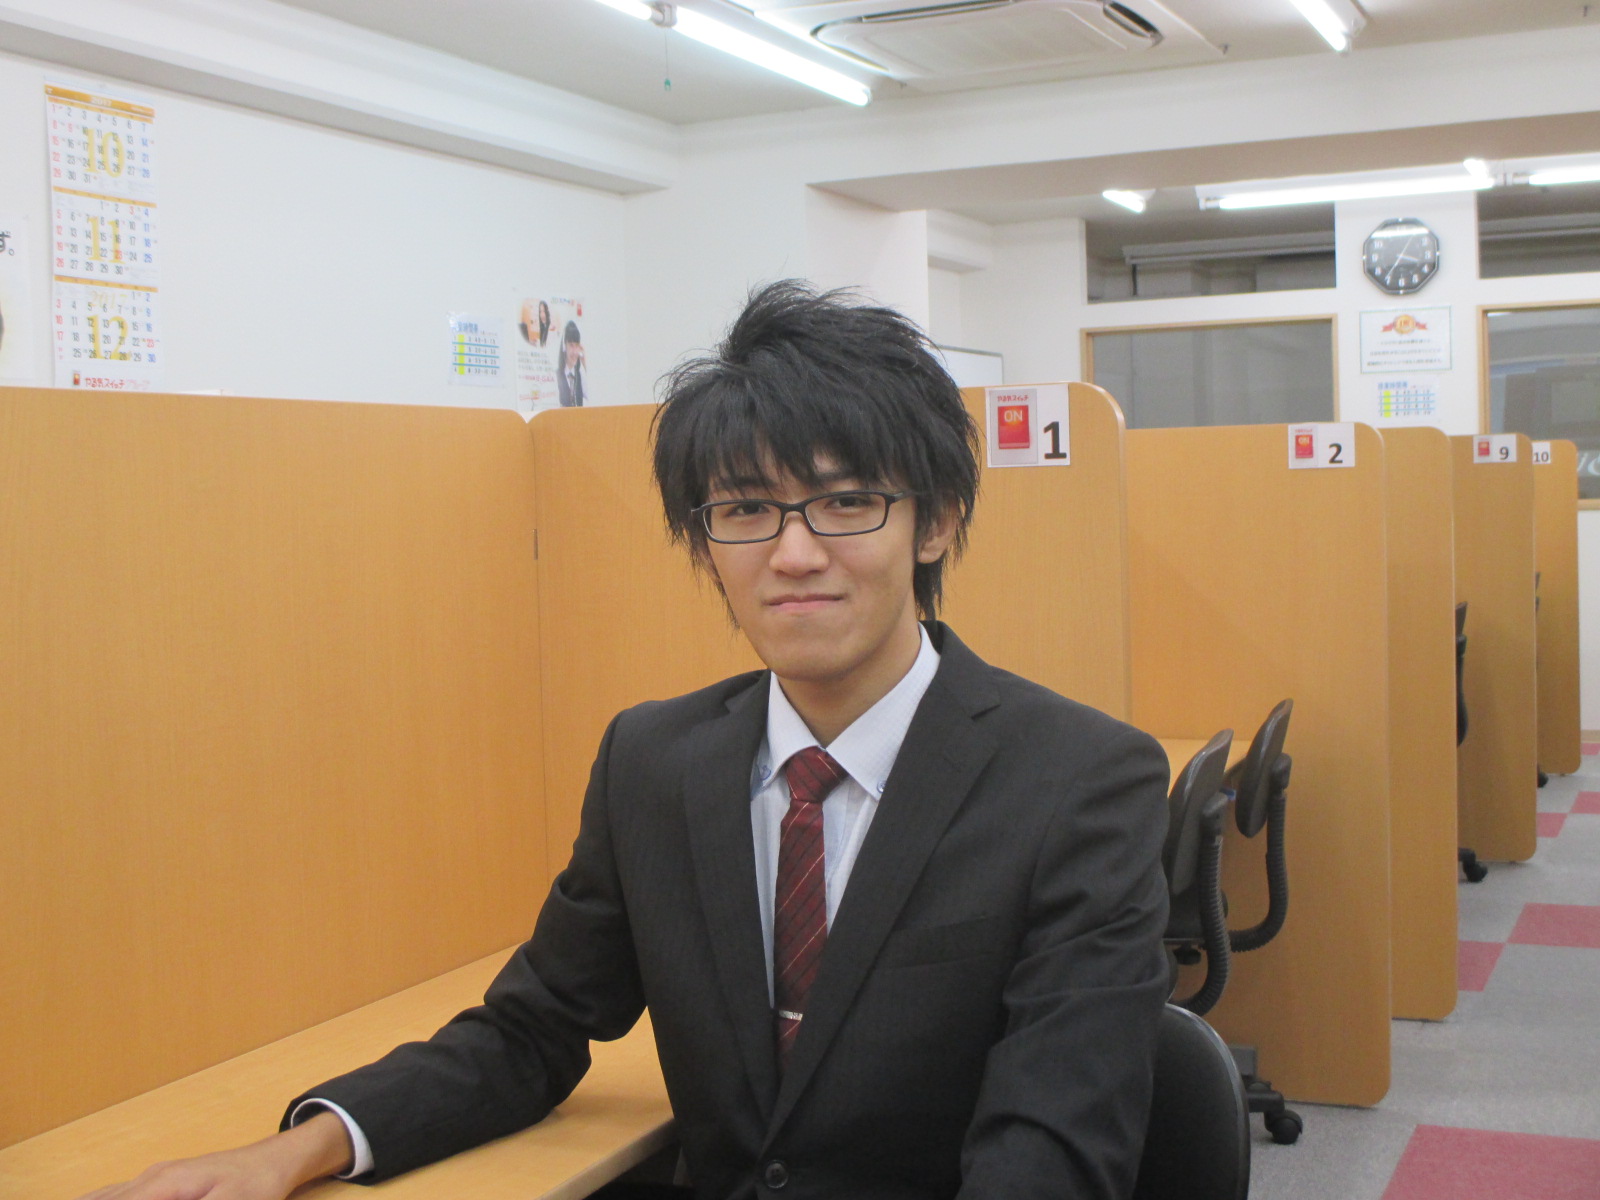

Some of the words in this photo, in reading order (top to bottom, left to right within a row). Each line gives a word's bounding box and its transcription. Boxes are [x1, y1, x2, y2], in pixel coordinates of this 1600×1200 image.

[85, 128, 125, 178] 10
[88, 216, 125, 264] 11
[87, 315, 131, 360] 12
[1004, 410, 1023, 422] ON
[1044, 421, 1067, 459] 1
[1328, 443, 1343, 464] 2
[1499, 447, 1509, 460] 9
[1534, 452, 1549, 462] 10
